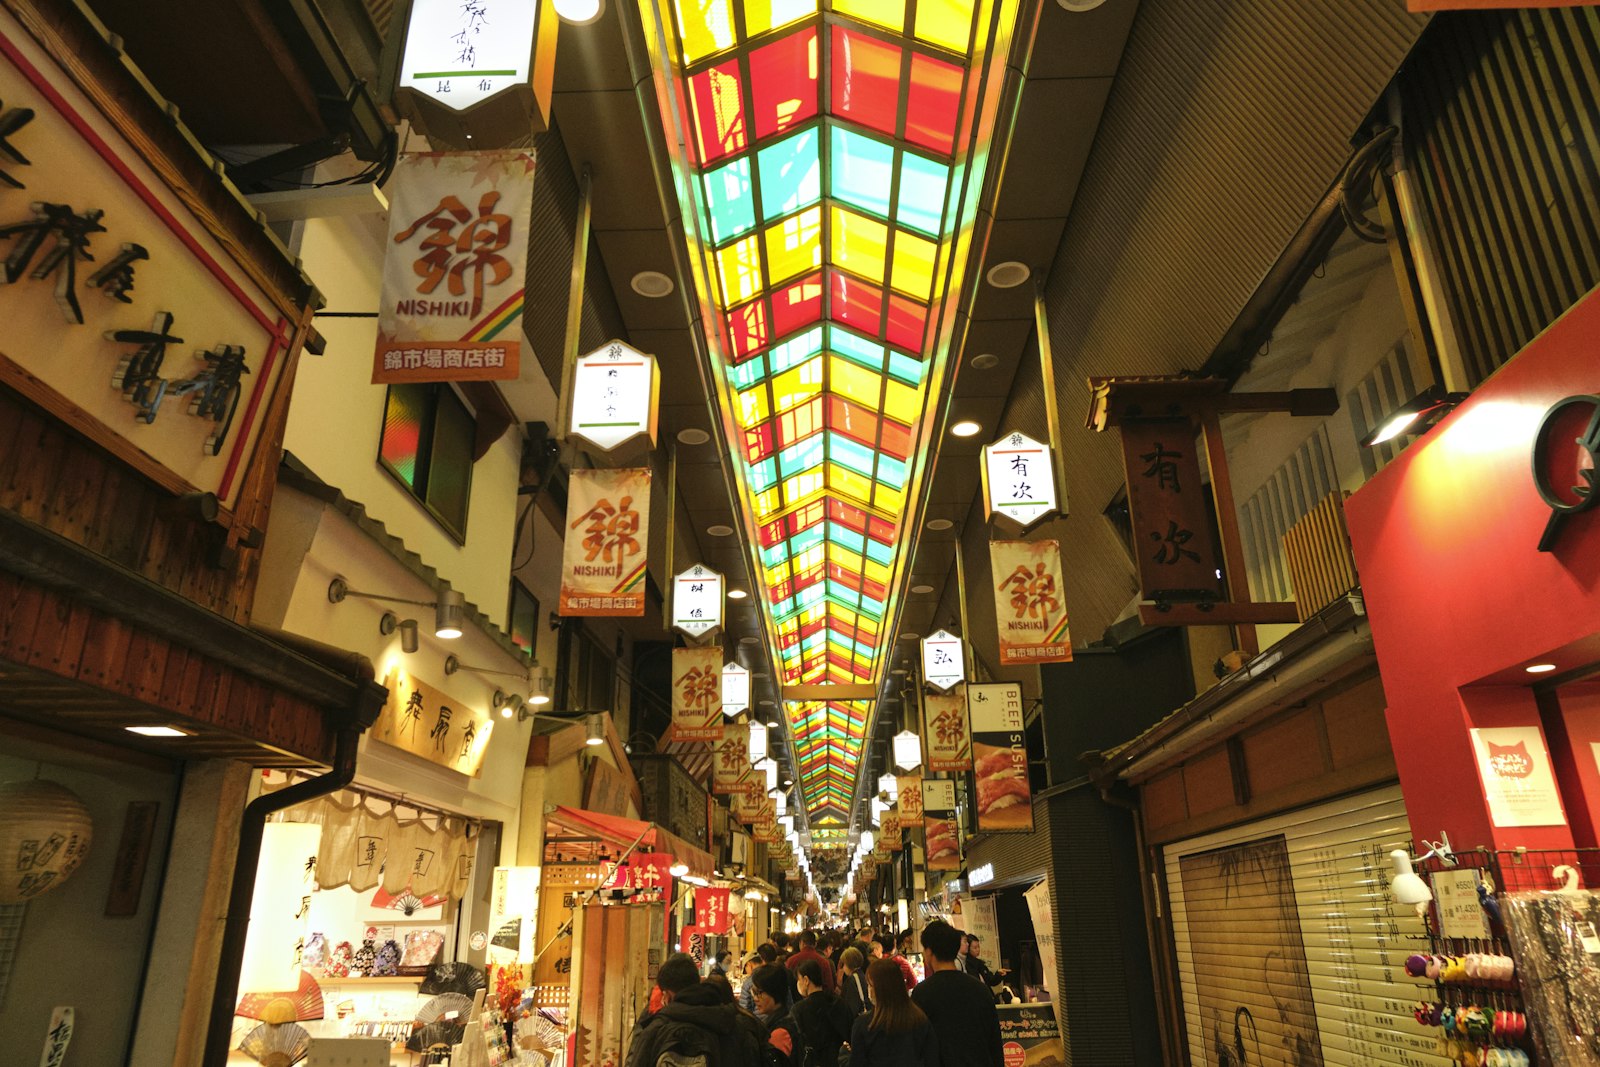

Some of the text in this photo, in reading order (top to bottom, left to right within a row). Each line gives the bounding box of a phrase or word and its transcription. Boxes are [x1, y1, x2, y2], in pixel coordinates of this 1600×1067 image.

[394, 190, 513, 321] 錦
[396, 300, 469, 316] NISHIKI
[384, 348, 505, 370] 錦市場商店街
[1010, 455, 1033, 499] 有次
[1139, 442, 1201, 565] 有次
[571, 495, 640, 579] 錦
[574, 565, 615, 576] NISHIKI
[999, 562, 1060, 632] 錦
[1008, 621, 1042, 630] NISHIKI
[675, 664, 719, 719] 錦
[929, 709, 965, 752] 錦
[1006, 690, 1025, 780] BEEF SUSHI
[719, 737, 747, 777] 錦
[945, 783, 953, 807] BEEF
